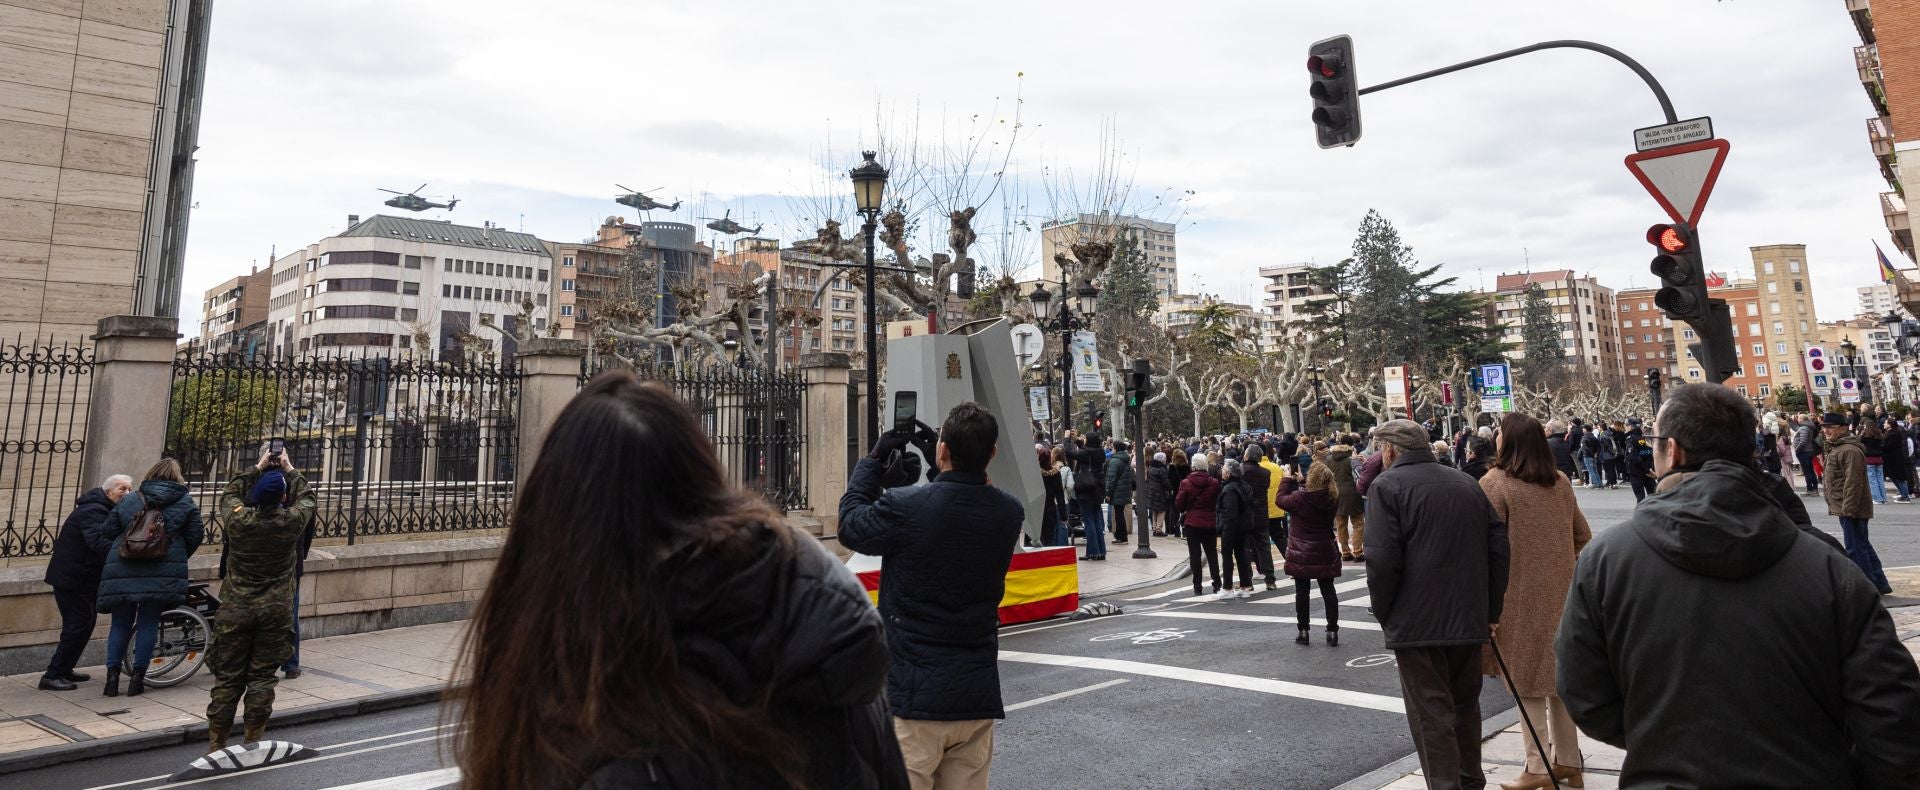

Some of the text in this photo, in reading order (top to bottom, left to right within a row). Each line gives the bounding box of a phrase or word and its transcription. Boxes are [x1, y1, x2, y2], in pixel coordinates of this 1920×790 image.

[1674, 122, 1700, 132] SEMAFORO
[1642, 136, 1675, 146] INTERMITENTE
[1684, 130, 1706, 138] APAGADO
[1487, 369, 1499, 384] P
